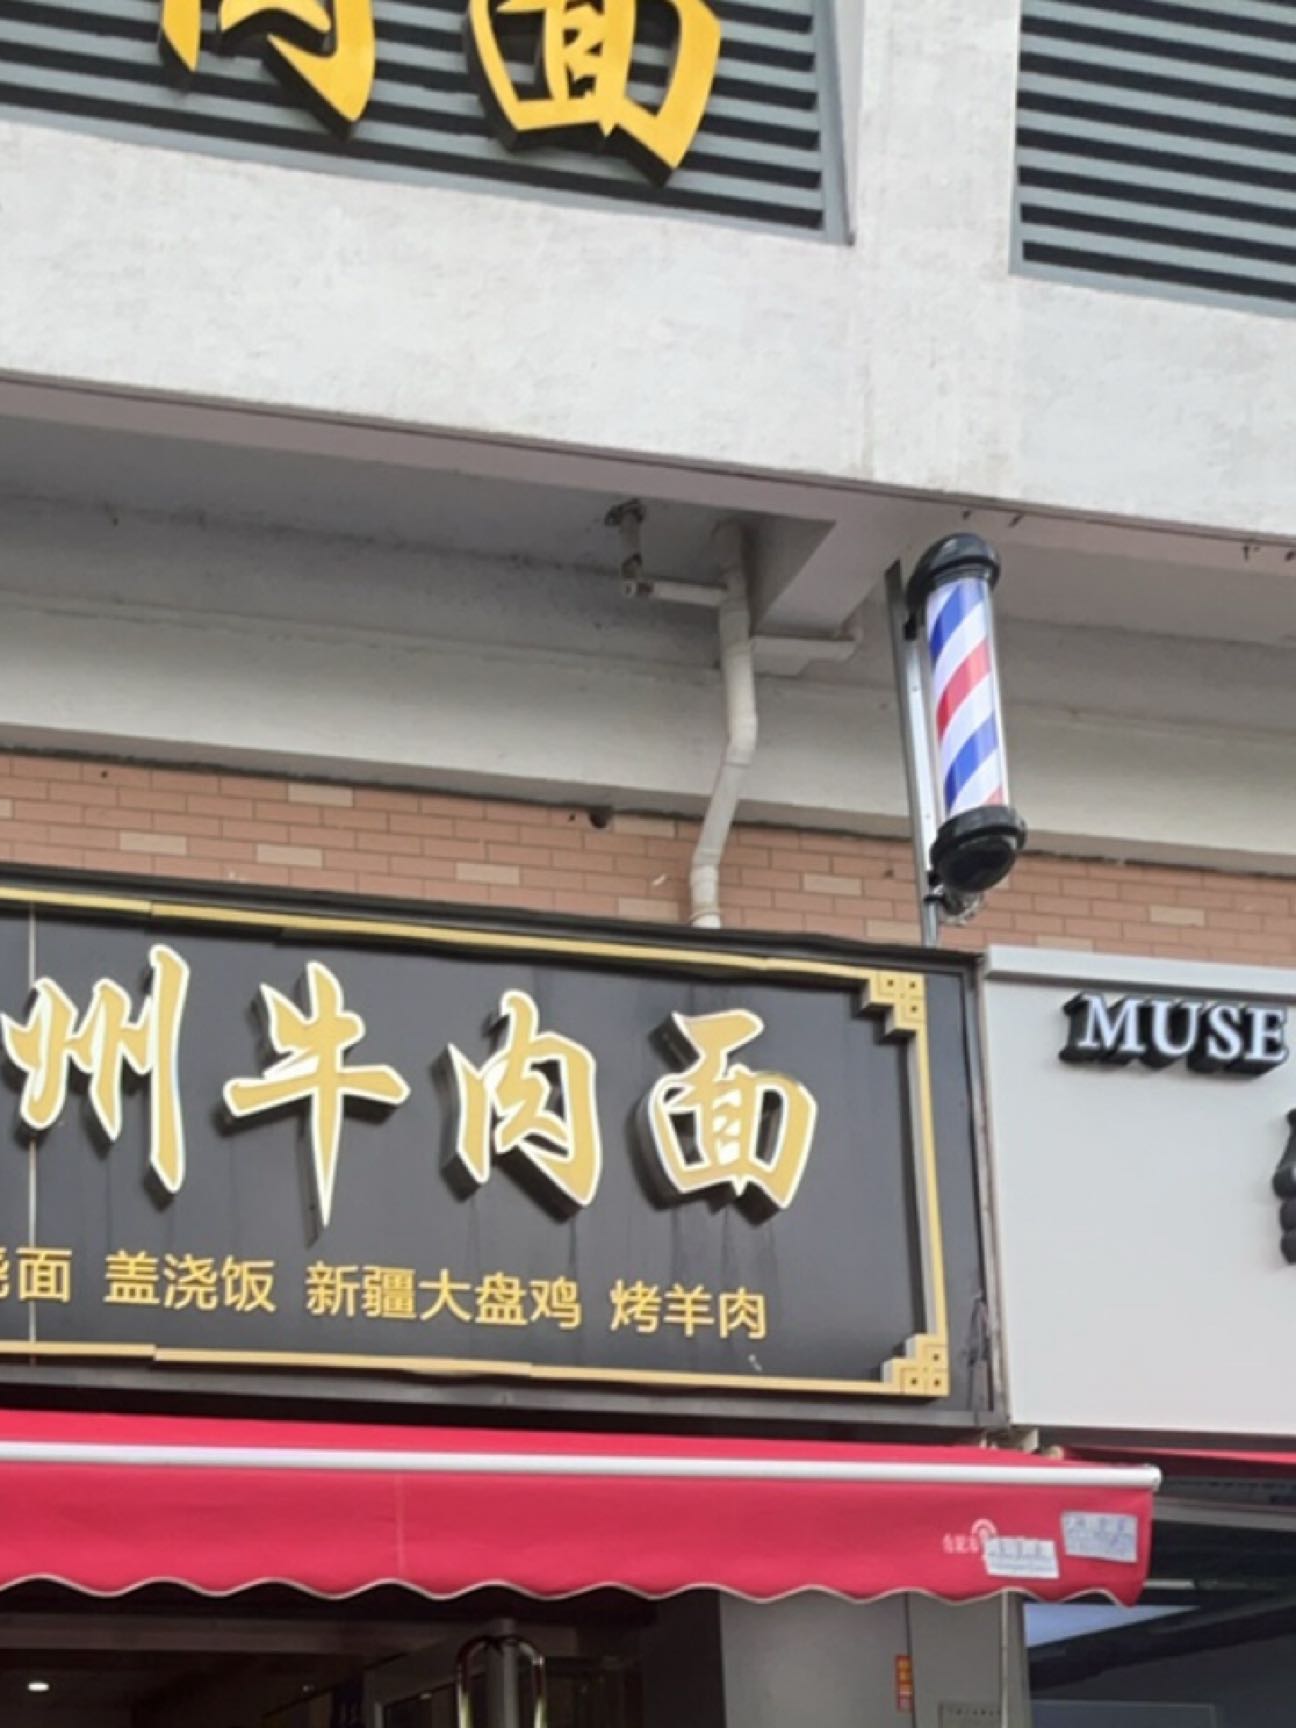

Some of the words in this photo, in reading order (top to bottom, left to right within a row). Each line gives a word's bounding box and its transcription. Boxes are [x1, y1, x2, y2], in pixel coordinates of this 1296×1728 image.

[1077, 993, 1289, 1062] MUSE
[103, 1250, 277, 1313] 盖浇饭
[305, 1260, 584, 1332] 新疆大盘鸡
[609, 1279, 767, 1340] 烤羊肉
